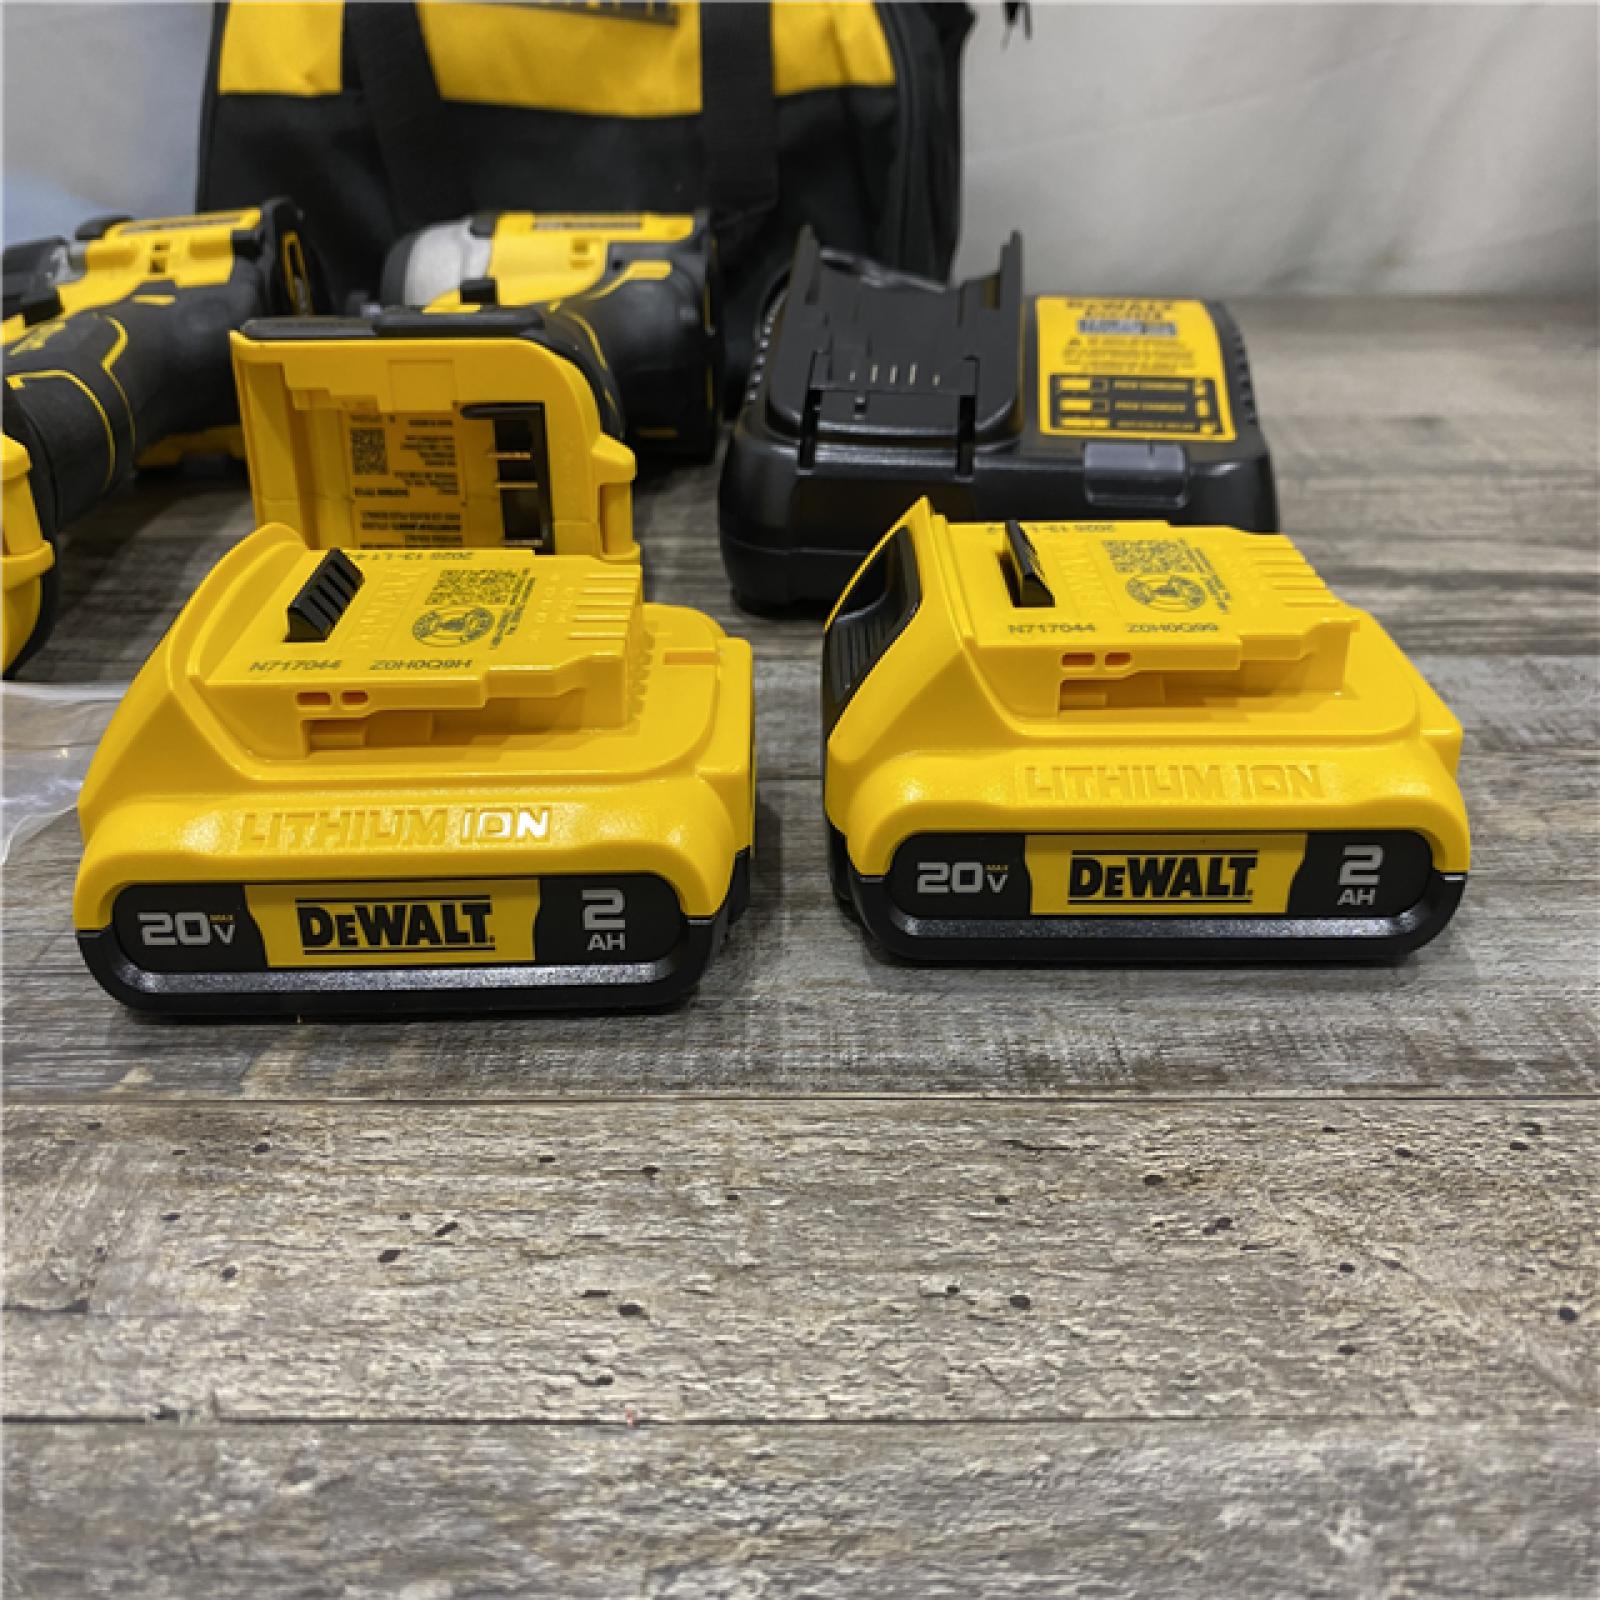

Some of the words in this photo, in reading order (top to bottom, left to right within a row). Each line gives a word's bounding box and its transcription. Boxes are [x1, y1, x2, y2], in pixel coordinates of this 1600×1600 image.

[249, 659, 342, 671] N717044
[1024, 763, 1223, 801] LITHIUM
[1234, 763, 1327, 799] ION
[239, 810, 449, 848] LITHIUM
[459, 804, 552, 843] ION
[1337, 845, 1384, 886] 2
[581, 888, 627, 931] 2
[1336, 888, 1377, 906] AH
[587, 933, 626, 951] AH
